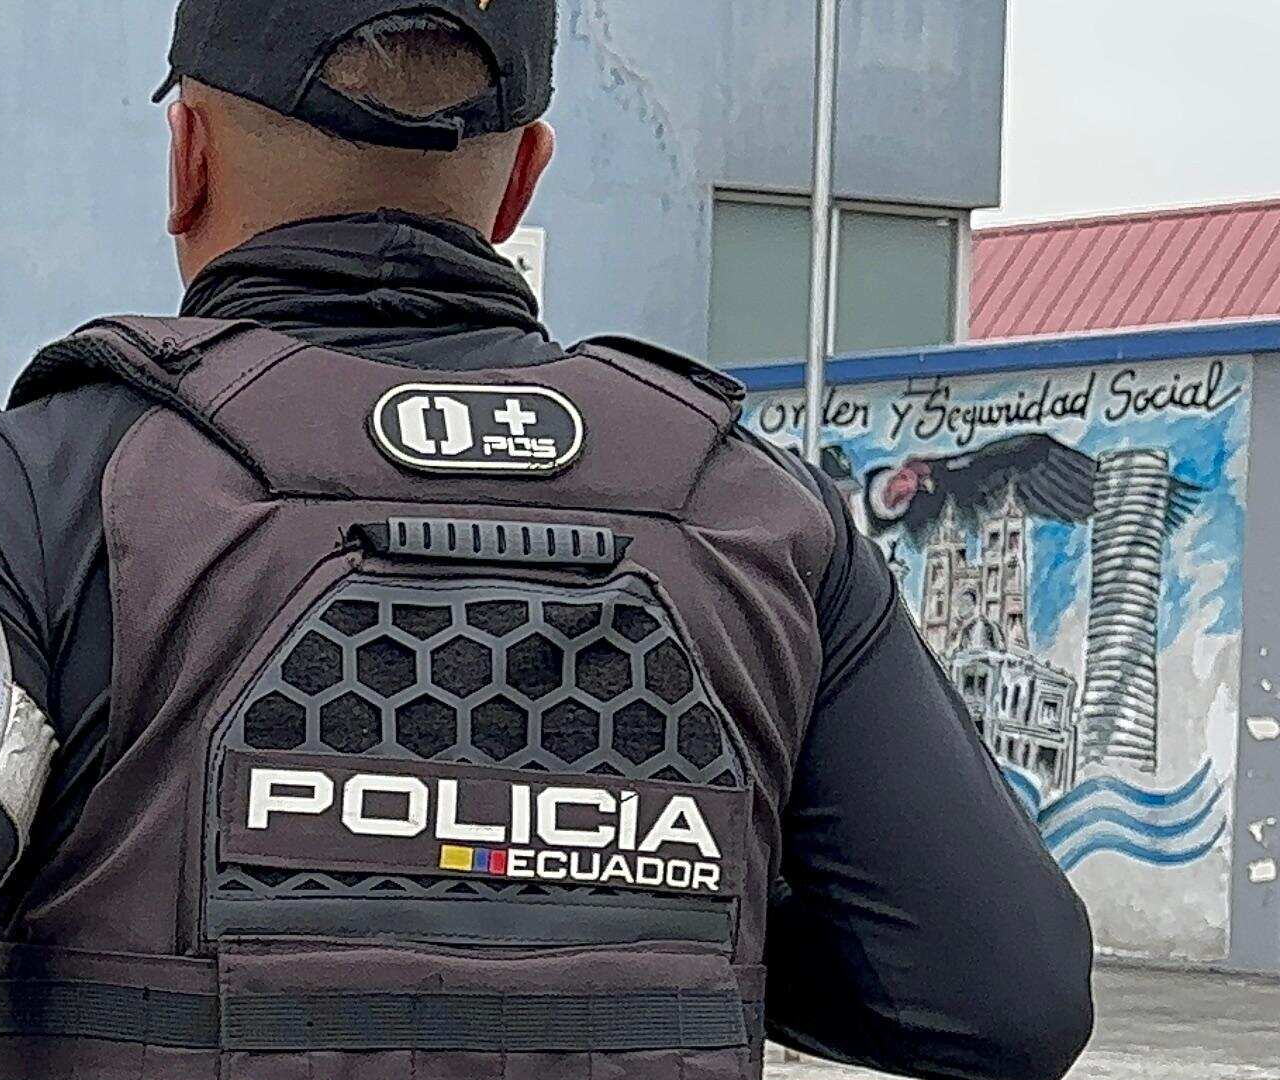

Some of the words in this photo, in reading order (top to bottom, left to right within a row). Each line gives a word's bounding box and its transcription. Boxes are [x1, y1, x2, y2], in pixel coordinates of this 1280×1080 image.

[915, 371, 1097, 447] Seguridad
[1105, 360, 1241, 422] Social
[483, 435, 557, 459] POS
[507, 848, 721, 891] ECUADOR
